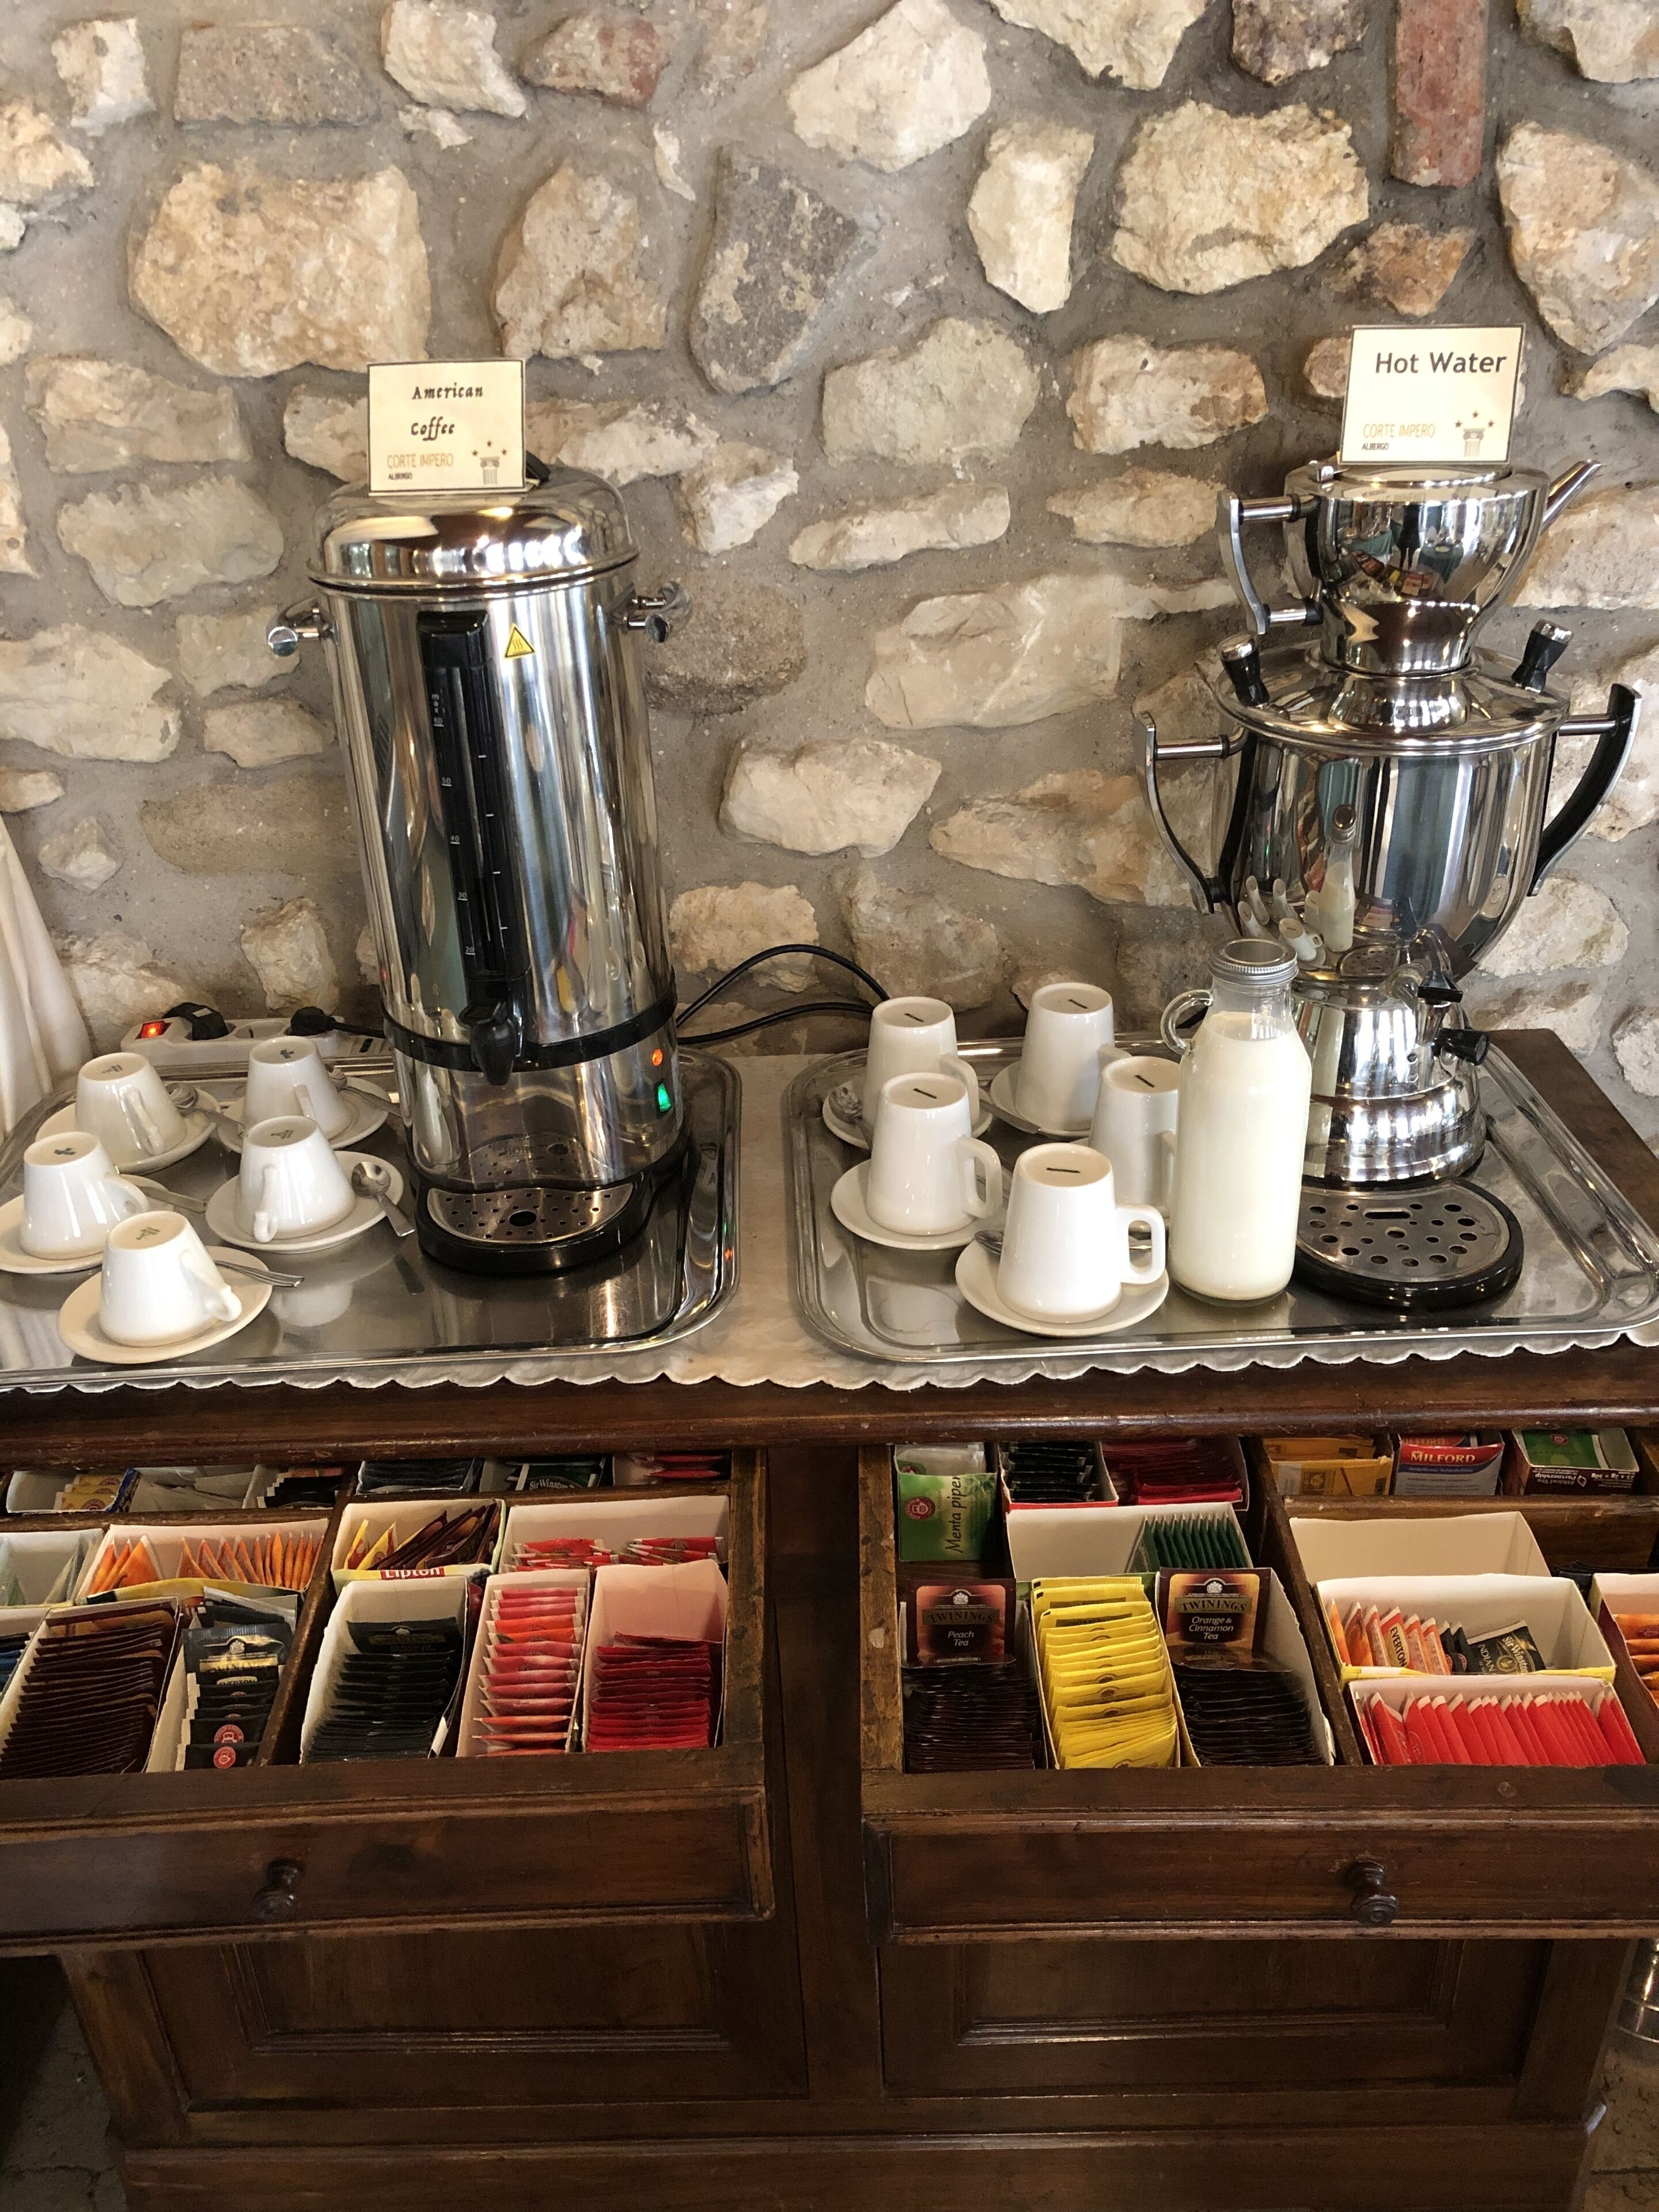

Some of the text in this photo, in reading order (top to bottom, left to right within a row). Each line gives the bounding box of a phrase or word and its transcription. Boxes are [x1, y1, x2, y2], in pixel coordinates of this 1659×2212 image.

[1375, 351, 1508, 374] Hot Water
[411, 382, 484, 400] American
[411, 416, 455, 441] Coffee
[1363, 423, 1435, 439] CORTE IMPERO
[1362, 442, 1389, 451] ALBERGO
[387, 453, 454, 469] CORTE IMPERO
[388, 472, 413, 480] ALBERGO
[1411, 1452, 1476, 1463] MILFORD
[529, 1481, 539, 1490] Sir
[945, 1513, 964, 1554] Menta
[1181, 1599, 1247, 1612] TWININGS
[928, 1611, 995, 1623] TWININGS
[1191, 1616, 1225, 1625] Orange
[948, 1630, 975, 1638] Peach
[1390, 1626, 1407, 1667] EVERTON
[1502, 1636, 1514, 1650] Sir
